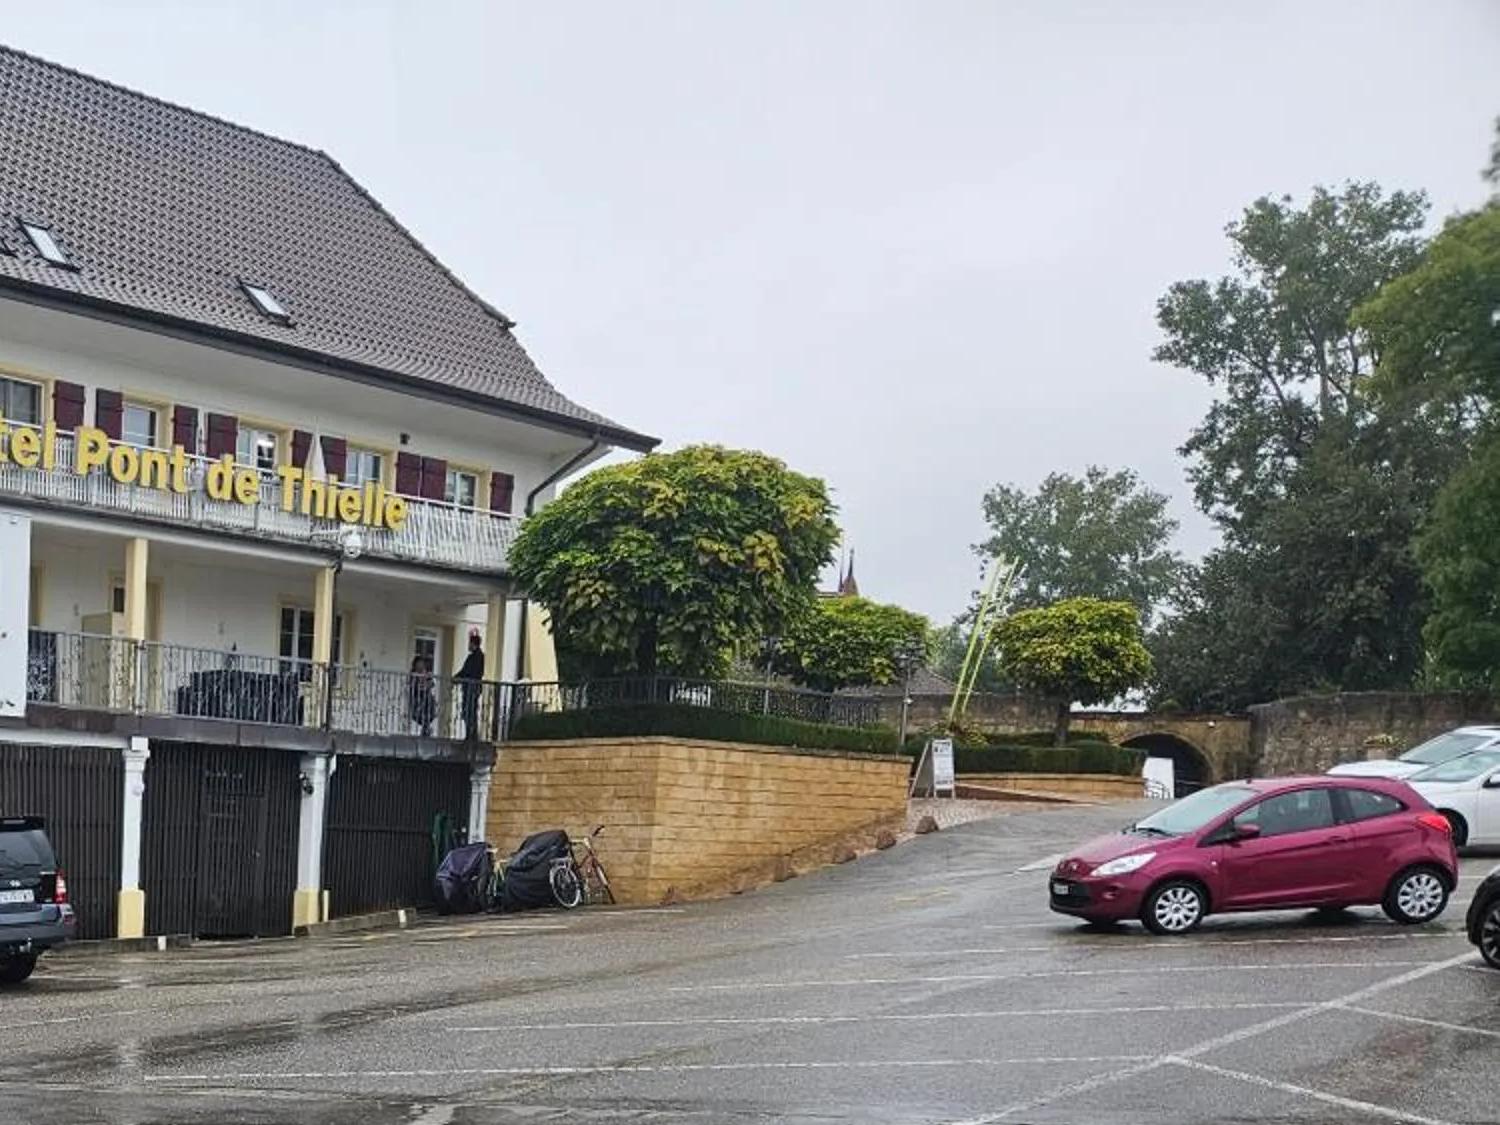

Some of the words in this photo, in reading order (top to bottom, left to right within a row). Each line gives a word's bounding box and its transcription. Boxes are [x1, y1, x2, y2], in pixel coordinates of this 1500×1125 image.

[76, 426, 190, 493] Pont
[207, 454, 260, 504] de
[277, 466, 408, 530] Thielle
